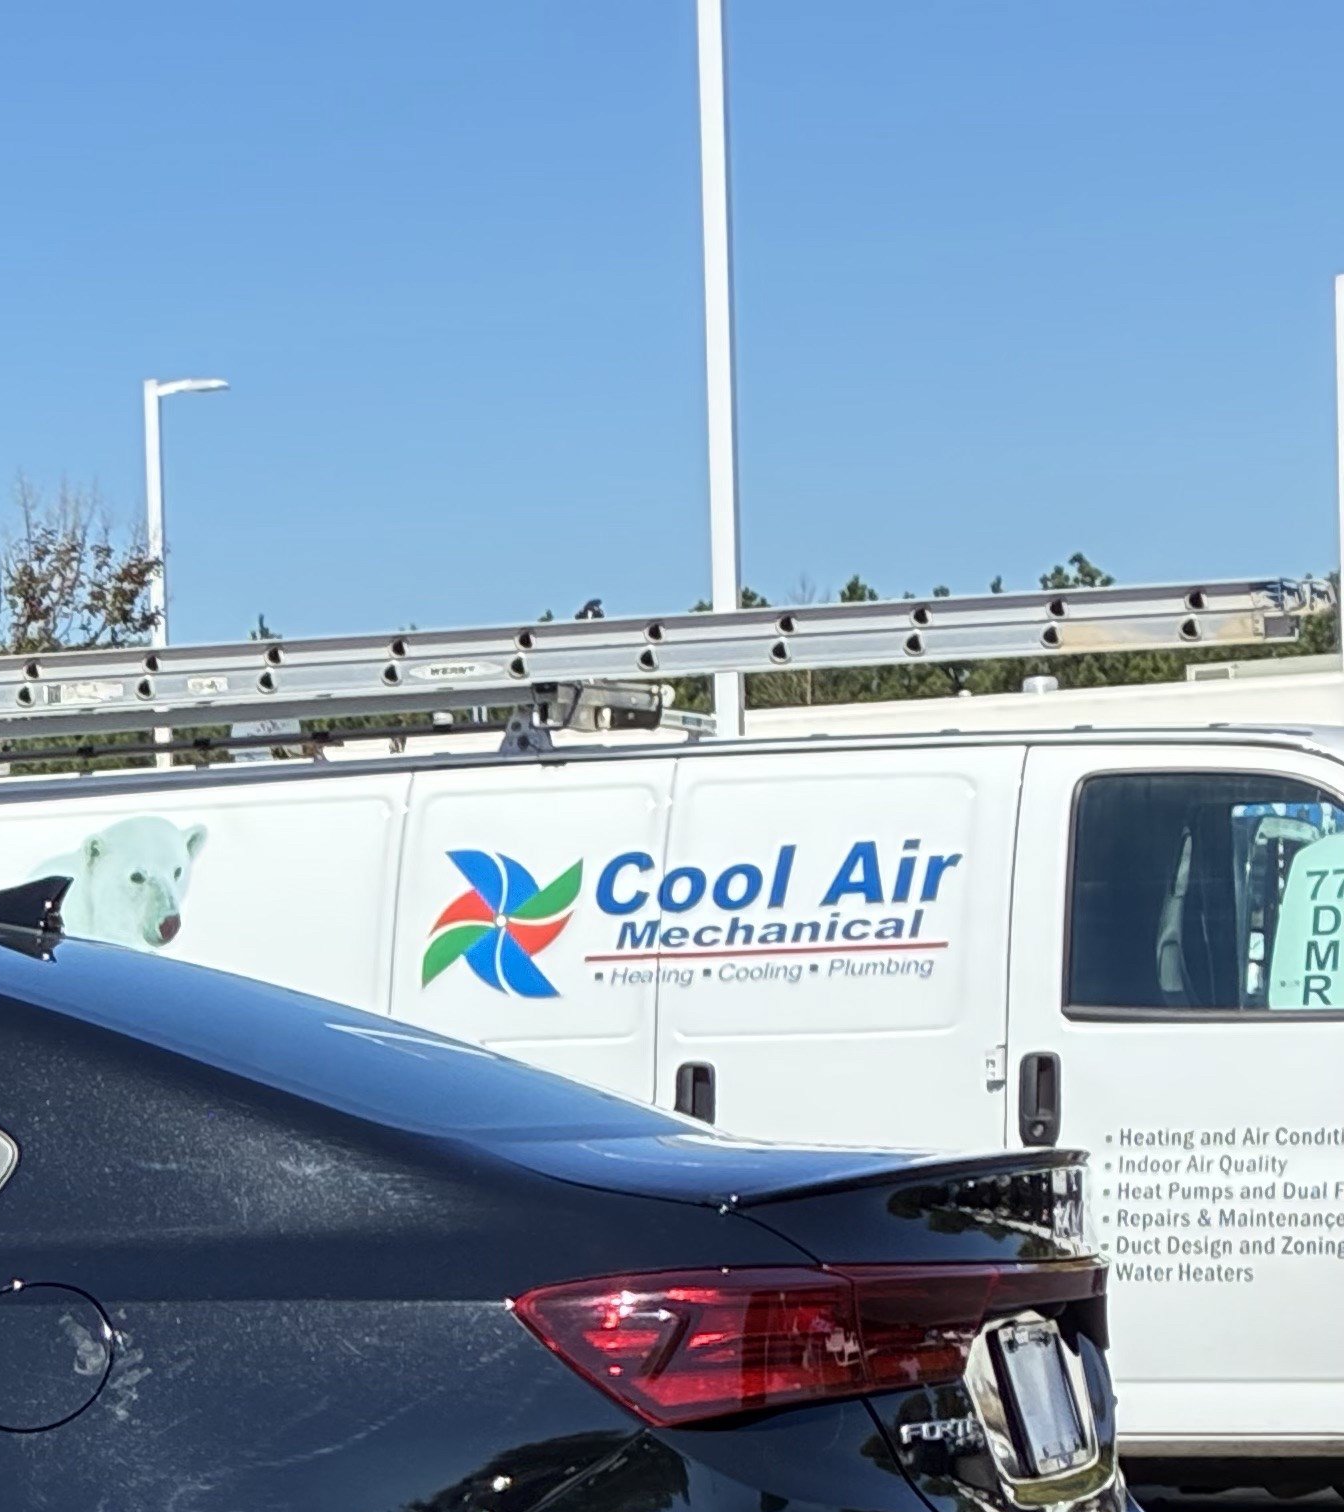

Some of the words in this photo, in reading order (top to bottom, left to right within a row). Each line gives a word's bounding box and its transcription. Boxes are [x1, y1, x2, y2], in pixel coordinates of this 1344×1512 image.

[595, 844, 797, 916] Cool
[819, 839, 963, 907] Air
[616, 910, 924, 951] Mechanical
[718, 961, 803, 986] Cooling
[828, 957, 935, 980] Plumbing
[1119, 1128, 1194, 1149] Heating
[1200, 1128, 1236, 1146] and
[1242, 1127, 1270, 1146] Air
[1118, 1155, 1181, 1174] Indoor
[1185, 1155, 1214, 1174] Air
[1219, 1154, 1288, 1177] Quality
[1117, 1182, 1162, 1200] Heat
[1168, 1182, 1234, 1203] Pumps
[1239, 1182, 1276, 1200] and
[1283, 1181, 1328, 1200] Dual
[1116, 1208, 1191, 1231] Repairs
[1197, 1209, 1212, 1227] &
[1218, 1208, 1344, 1229] Maintenance
[1115, 1235, 1162, 1255] Duct
[1167, 1235, 1234, 1259] Design
[1238, 1236, 1276, 1255] and
[1280, 1235, 1344, 1260] Zoning
[1115, 1262, 1173, 1282] Water
[1178, 1262, 1254, 1282] Heaters
